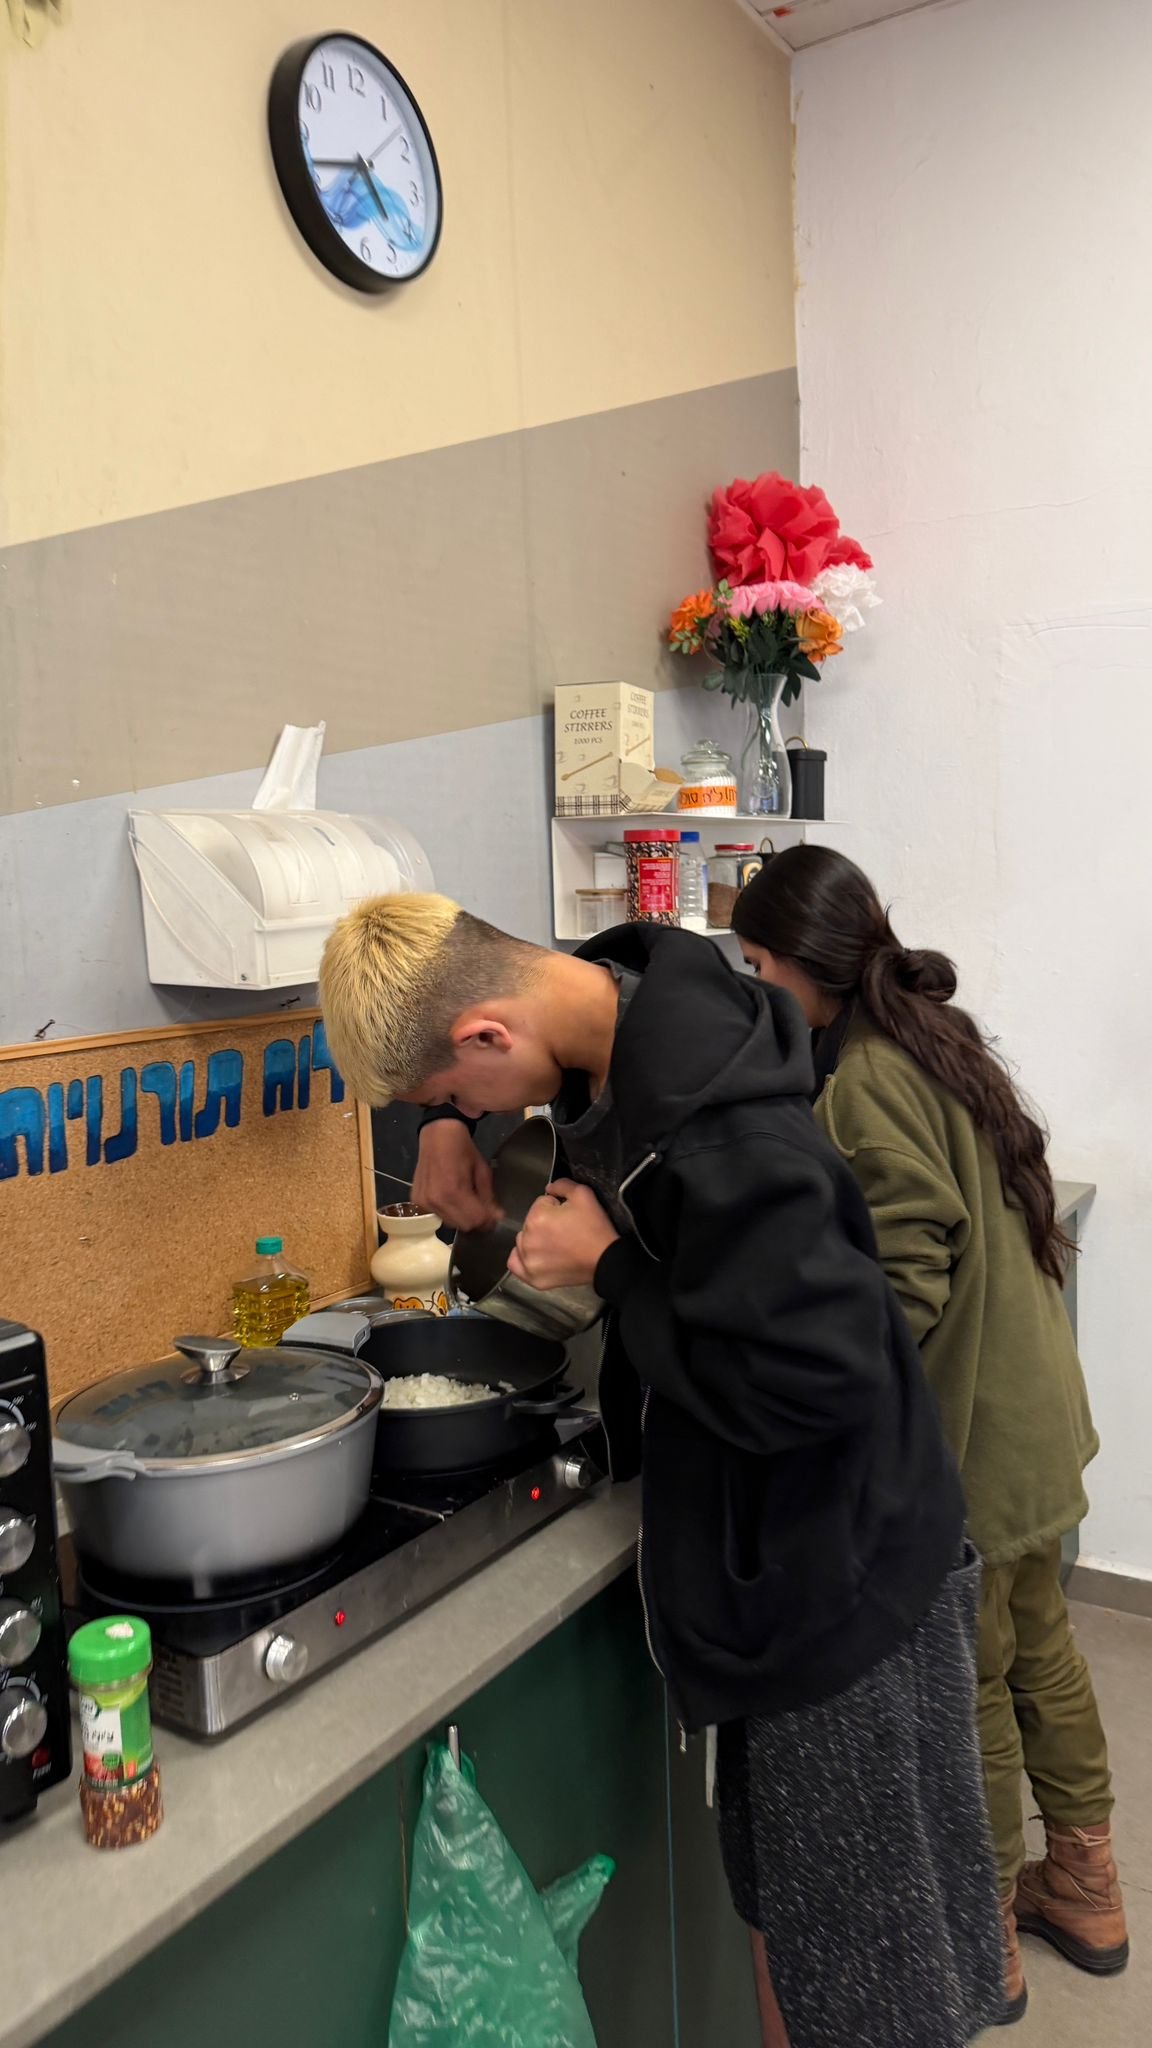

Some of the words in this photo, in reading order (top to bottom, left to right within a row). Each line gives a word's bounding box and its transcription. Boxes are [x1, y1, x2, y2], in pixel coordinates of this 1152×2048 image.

[321, 61, 336, 94] 11
[347, 63, 366, 98] 12
[302, 79, 321, 113] 10
[380, 94, 388, 121] 1
[399, 134, 411, 165] 2
[408, 179, 420, 208] 3
[359, 236, 372, 263] 6
[563, 720, 613, 733] STIRRERS
[569, 707, 608, 720] COFFEE
[0, 1047, 243, 1181] תורנויות
